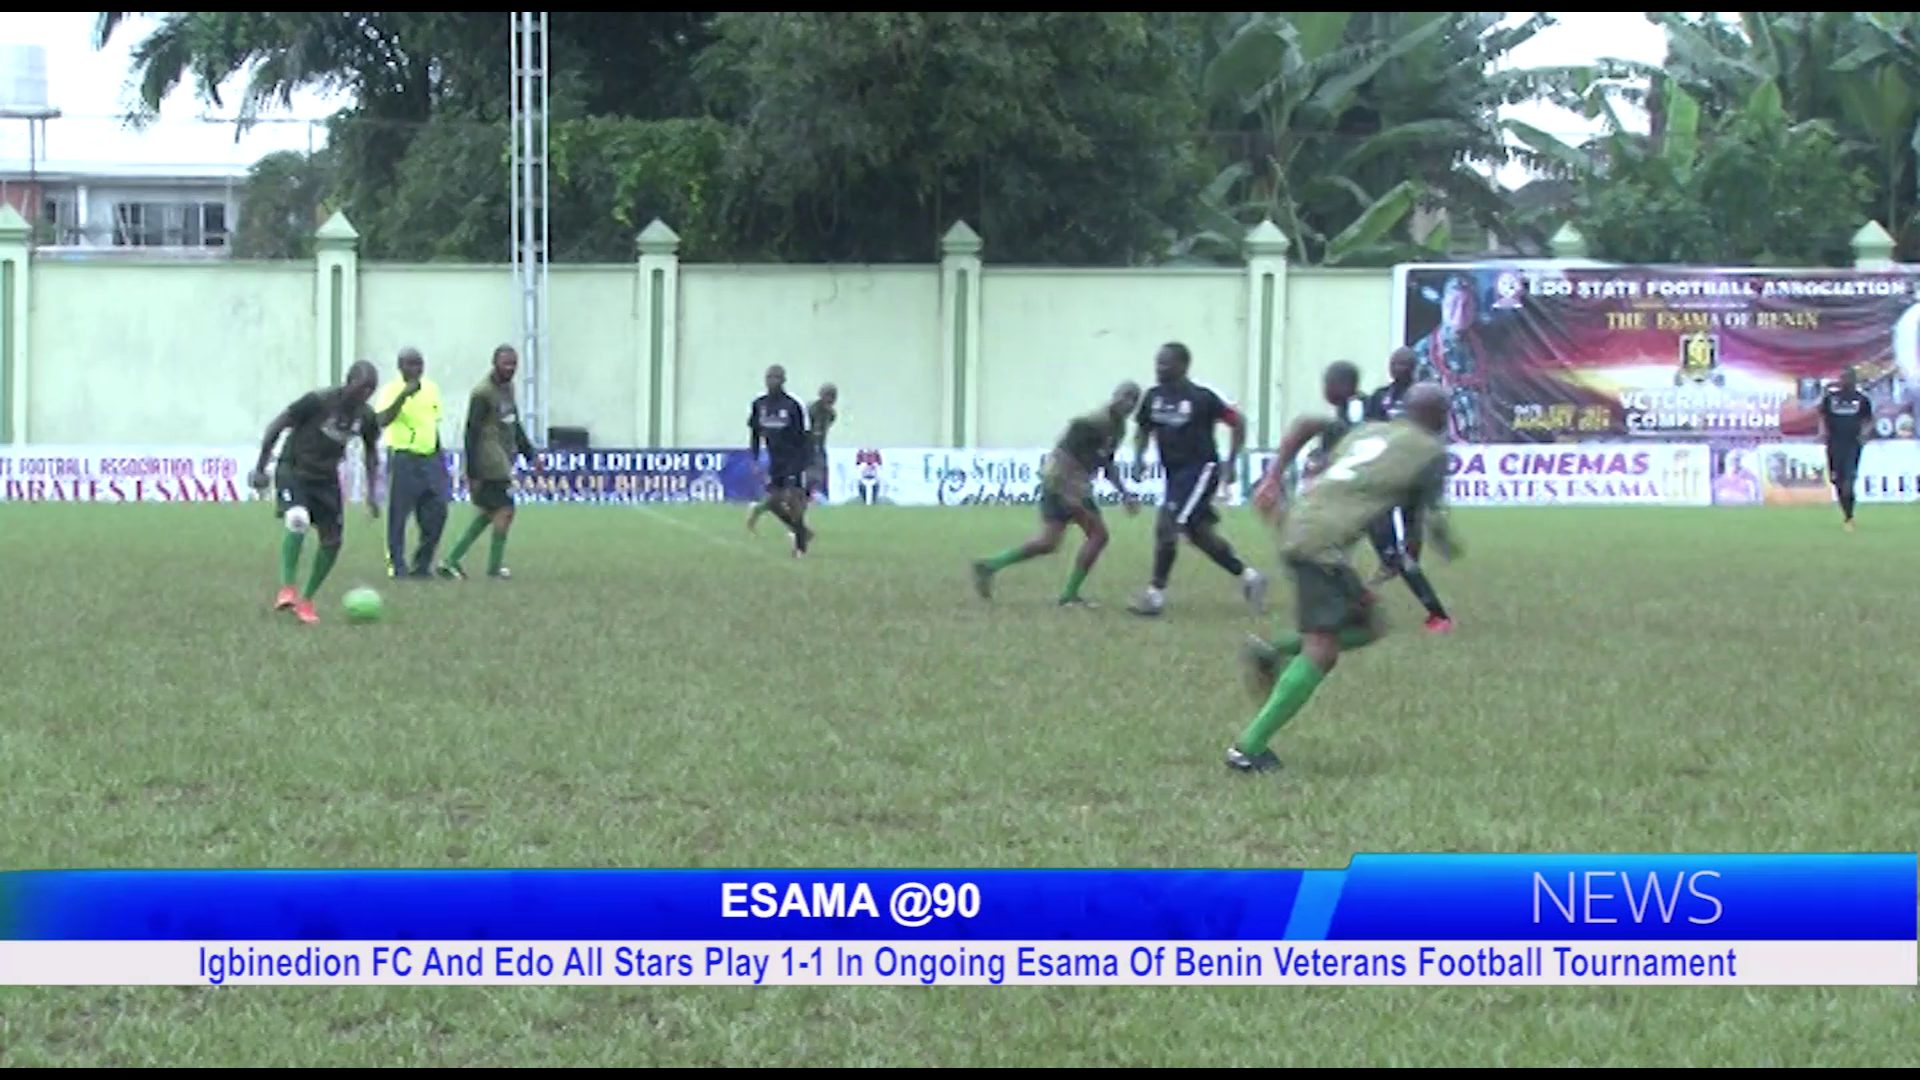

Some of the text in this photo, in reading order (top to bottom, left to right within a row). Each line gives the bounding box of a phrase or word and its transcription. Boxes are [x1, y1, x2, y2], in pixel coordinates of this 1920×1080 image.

[1578, 279, 1638, 298] STATE
[1646, 281, 1756, 296] FOOTBALL
[1762, 281, 1905, 297] ASSOCIATION
[1606, 311, 1820, 330] THE ESAMA OF BENIN
[1627, 412, 1780, 429] COMPETITION
[19, 457, 90, 477] FOOTBALL
[100, 457, 194, 478] ASSOCIATION
[592, 452, 690, 472] EDITION
[972, 453, 1031, 483] State
[1326, 435, 1389, 481] 2
[1498, 452, 1651, 476] CINEMAS
[134, 479, 240, 502] ESAMA
[613, 474, 688, 494] BENIN
[1566, 479, 1659, 498] ESAMA
